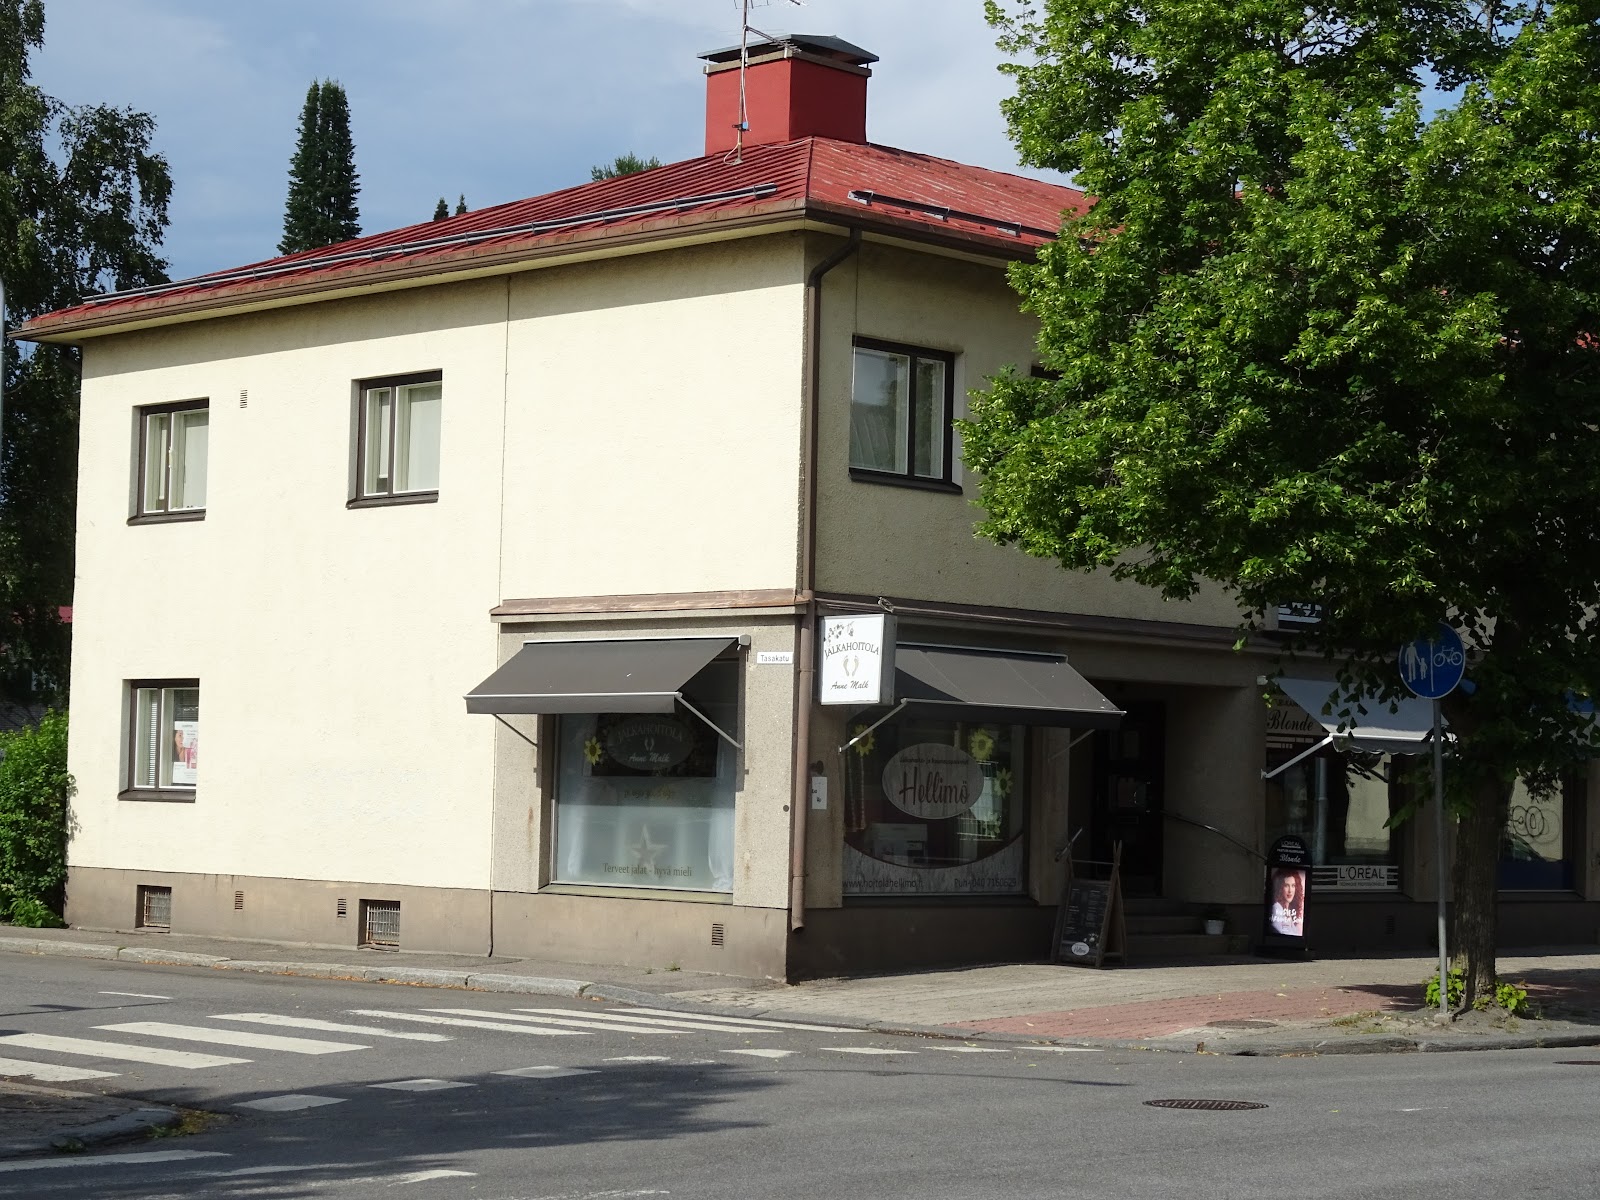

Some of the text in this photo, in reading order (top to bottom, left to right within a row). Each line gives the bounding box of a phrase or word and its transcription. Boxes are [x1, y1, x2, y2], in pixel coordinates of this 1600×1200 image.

[761, 654, 790, 662] Tasakatu
[824, 642, 879, 660] JALKAHOITOLA
[830, 680, 869, 690] Anne Malk
[1266, 710, 1314, 731] Blonde
[617, 722, 684, 743] JALKAHOITOLA
[899, 766, 971, 805] Hellimö
[602, 863, 629, 873] Terveet
[630, 864, 648, 875] jalat
[654, 864, 672, 878] hyvä
[673, 866, 693, 877] mieli
[1339, 866, 1385, 880] L'ORÉAL
